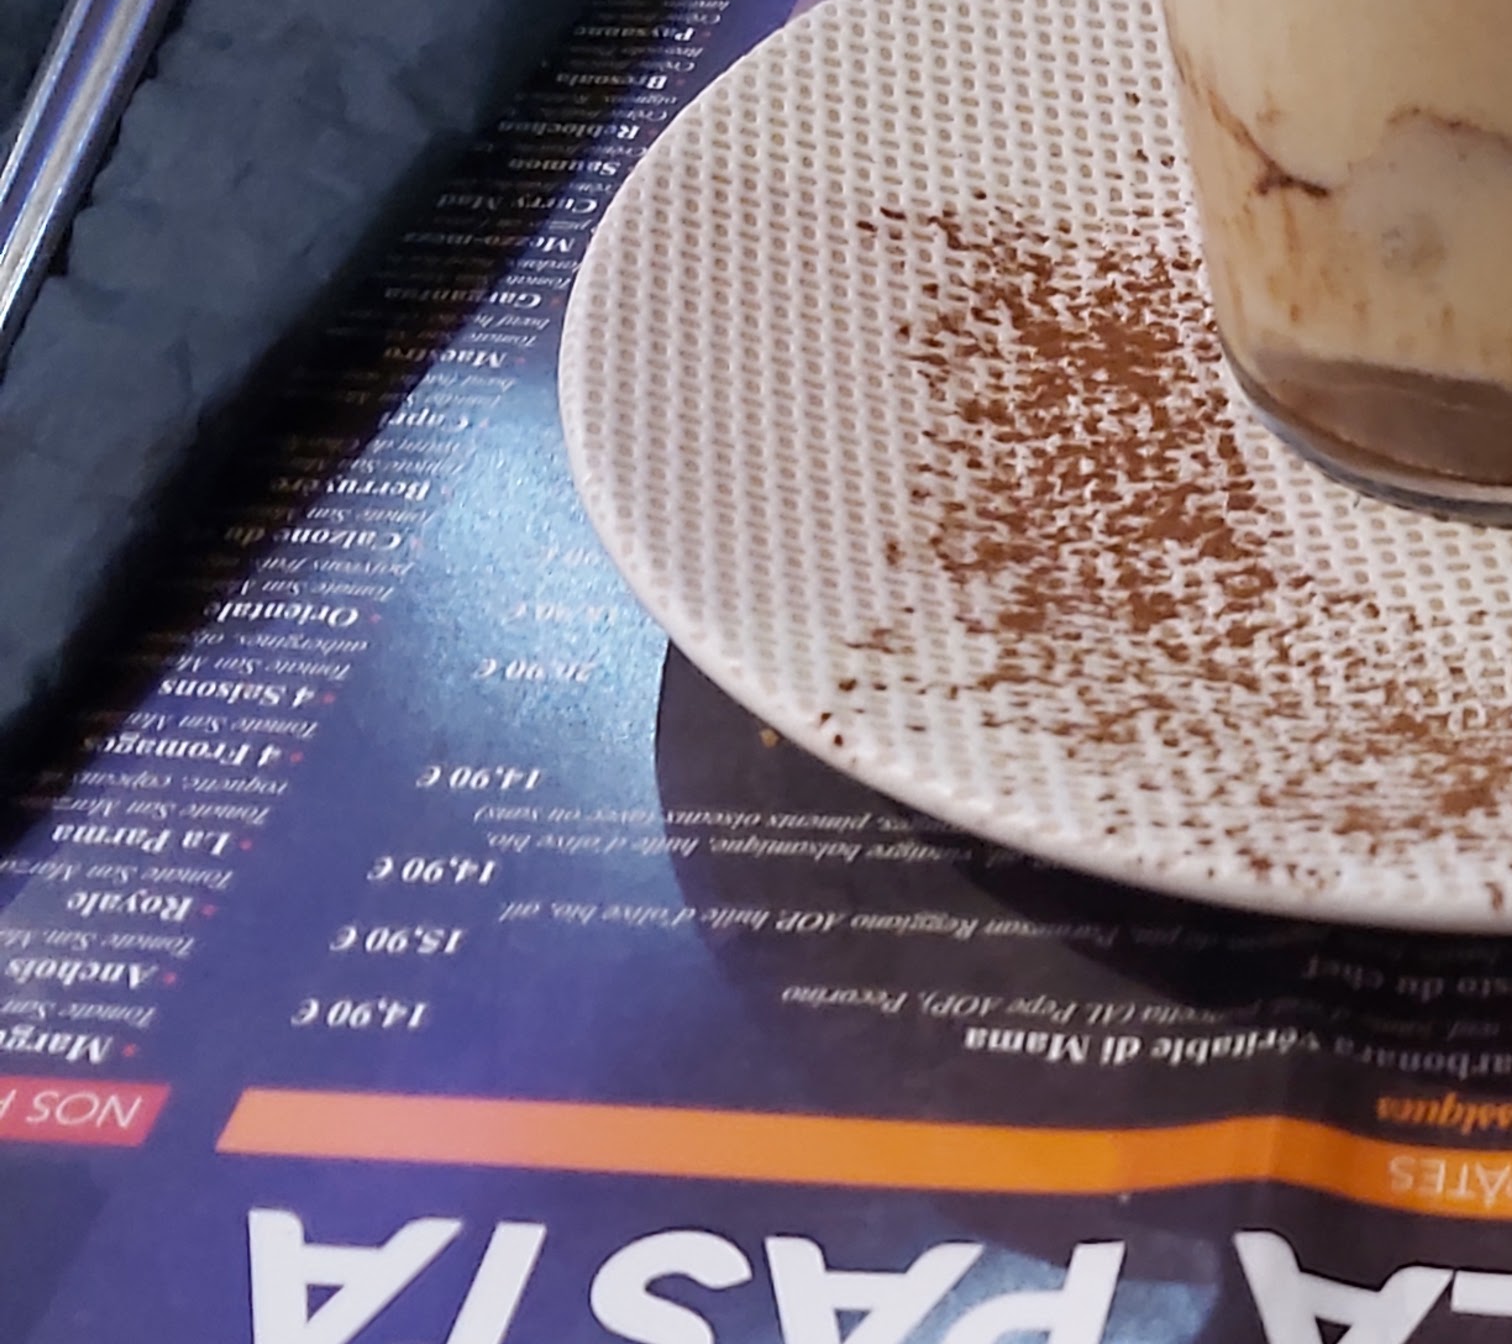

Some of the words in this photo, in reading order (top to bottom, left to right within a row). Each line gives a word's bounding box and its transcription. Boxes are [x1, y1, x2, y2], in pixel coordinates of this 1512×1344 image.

[156, 677, 287, 708] Saisons
[289, 685, 315, 708] 4
[256, 743, 282, 768] 4
[50, 823, 172, 853] Parma
[180, 829, 232, 857] La
[65, 889, 194, 923] Royale
[3, 957, 159, 990] Anchois
[963, 1025, 1092, 1064] Mama
[1101, 1033, 1141, 1068] di
[25, 1090, 144, 1130] NOS
